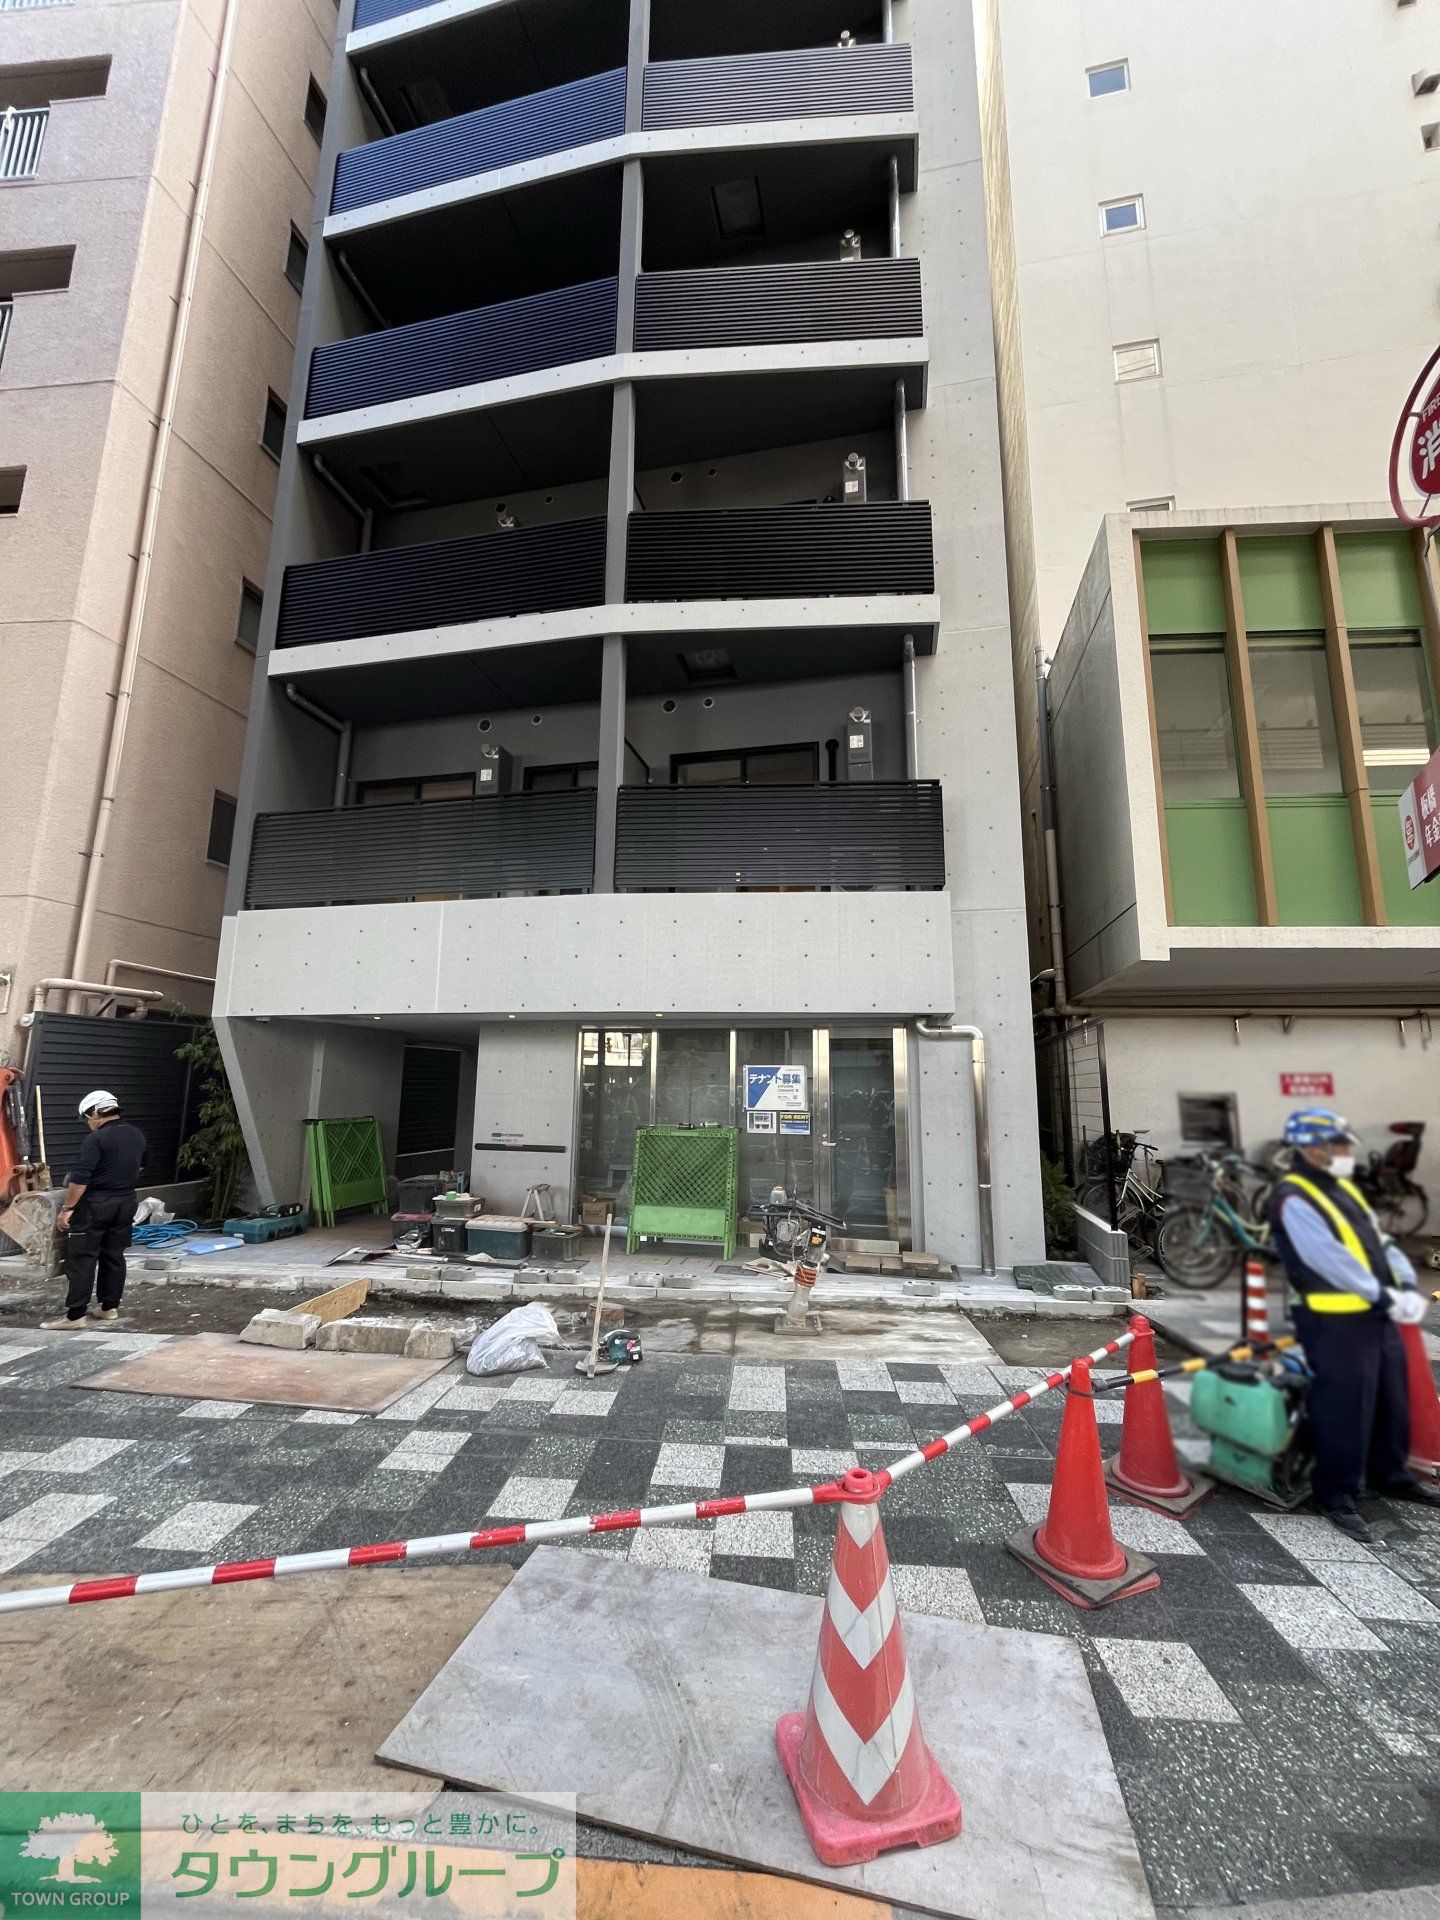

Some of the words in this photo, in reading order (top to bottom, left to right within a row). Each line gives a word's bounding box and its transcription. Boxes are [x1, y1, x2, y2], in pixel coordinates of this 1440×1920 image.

[749, 1073, 801, 1085] テナント募集
